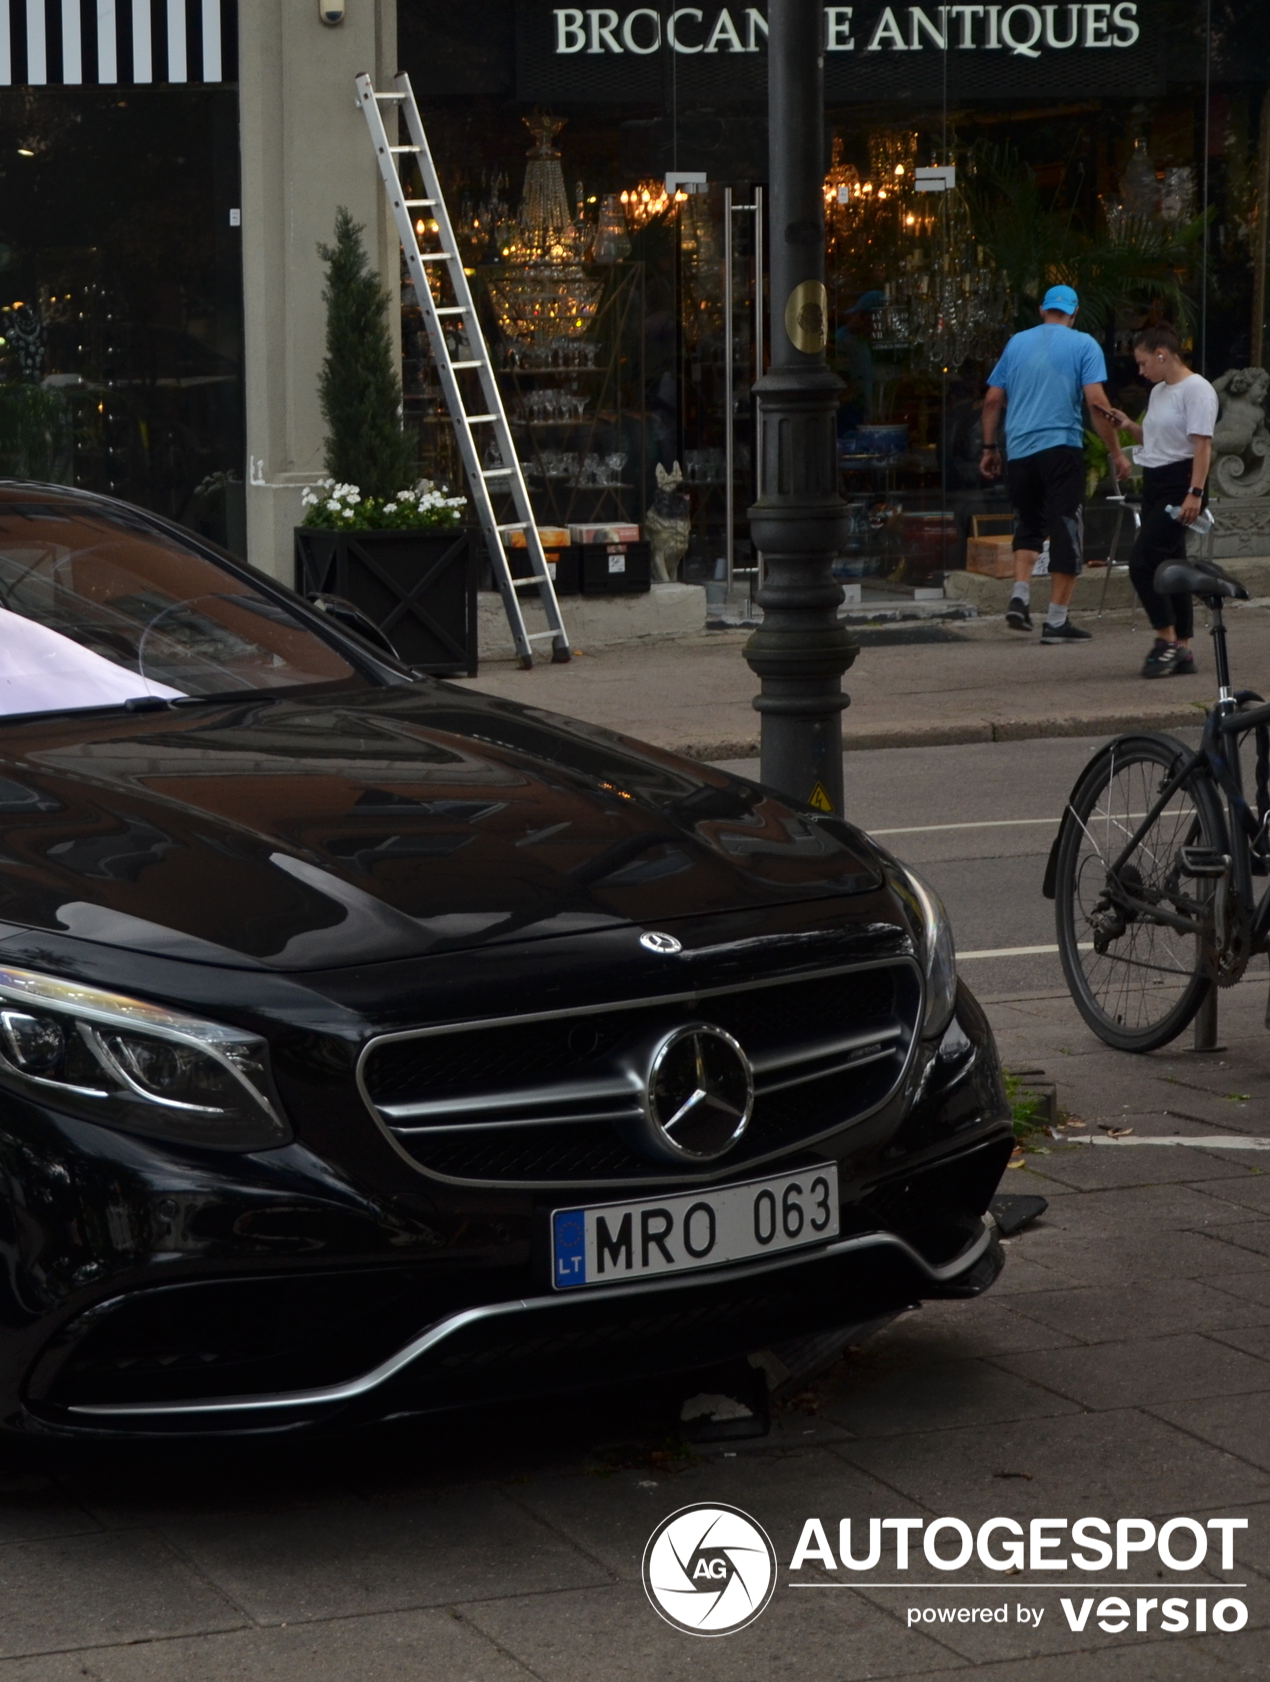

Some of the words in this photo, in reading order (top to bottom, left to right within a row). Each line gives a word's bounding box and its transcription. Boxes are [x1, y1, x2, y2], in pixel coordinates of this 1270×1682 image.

[553, 7, 855, 54] BROCANE
[867, 2, 1140, 58] ANTIQUES
[595, 1201, 717, 1274] MRO
[753, 1176, 832, 1246] 063
[558, 1255, 583, 1275] LT
